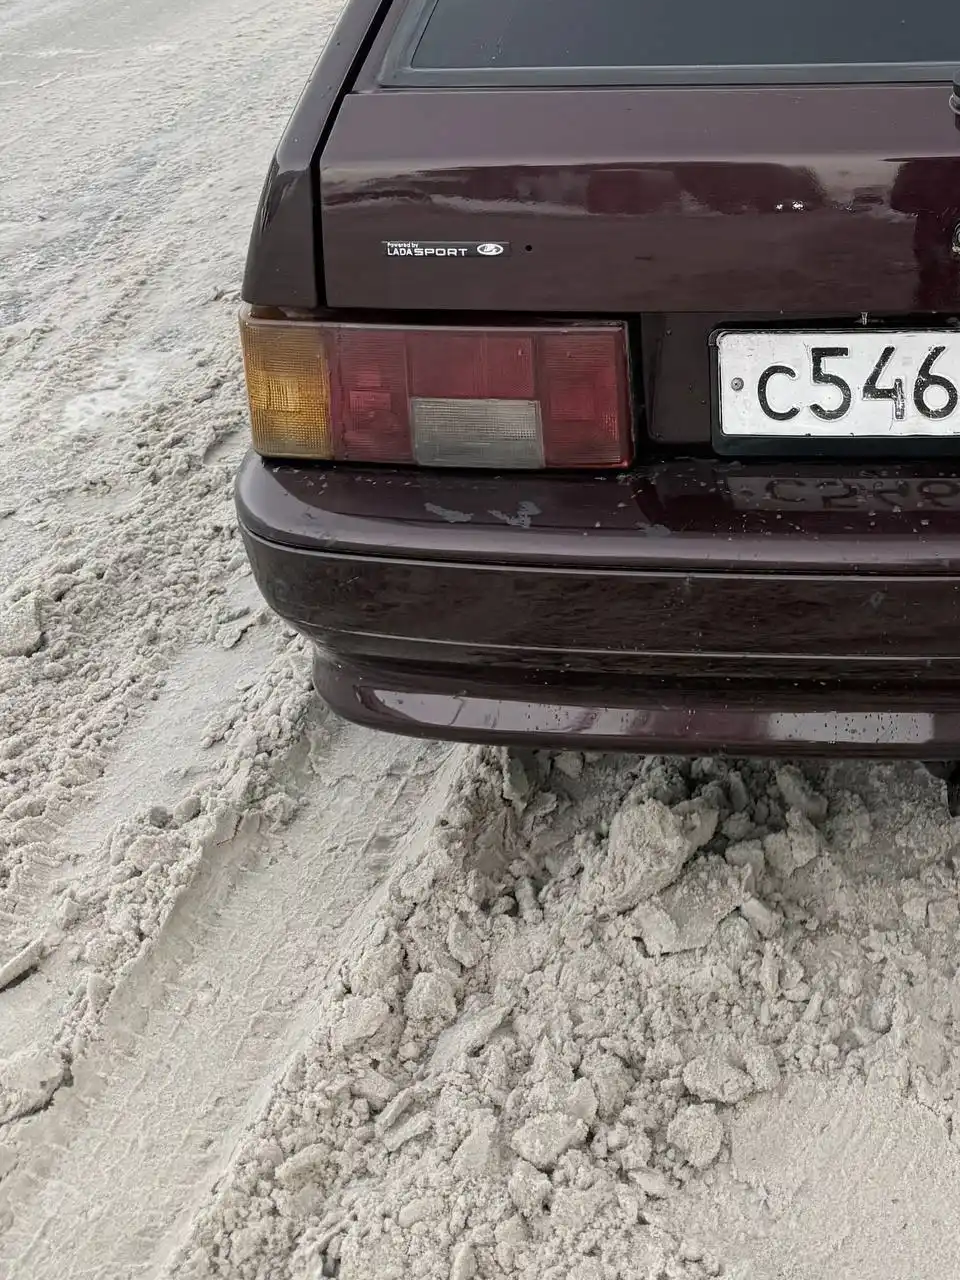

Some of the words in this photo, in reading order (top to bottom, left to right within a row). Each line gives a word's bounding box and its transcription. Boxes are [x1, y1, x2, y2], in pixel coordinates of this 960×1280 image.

[412, 241, 419, 249] by
[387, 247, 413, 256] LADA
[413, 248, 468, 256] SPORT
